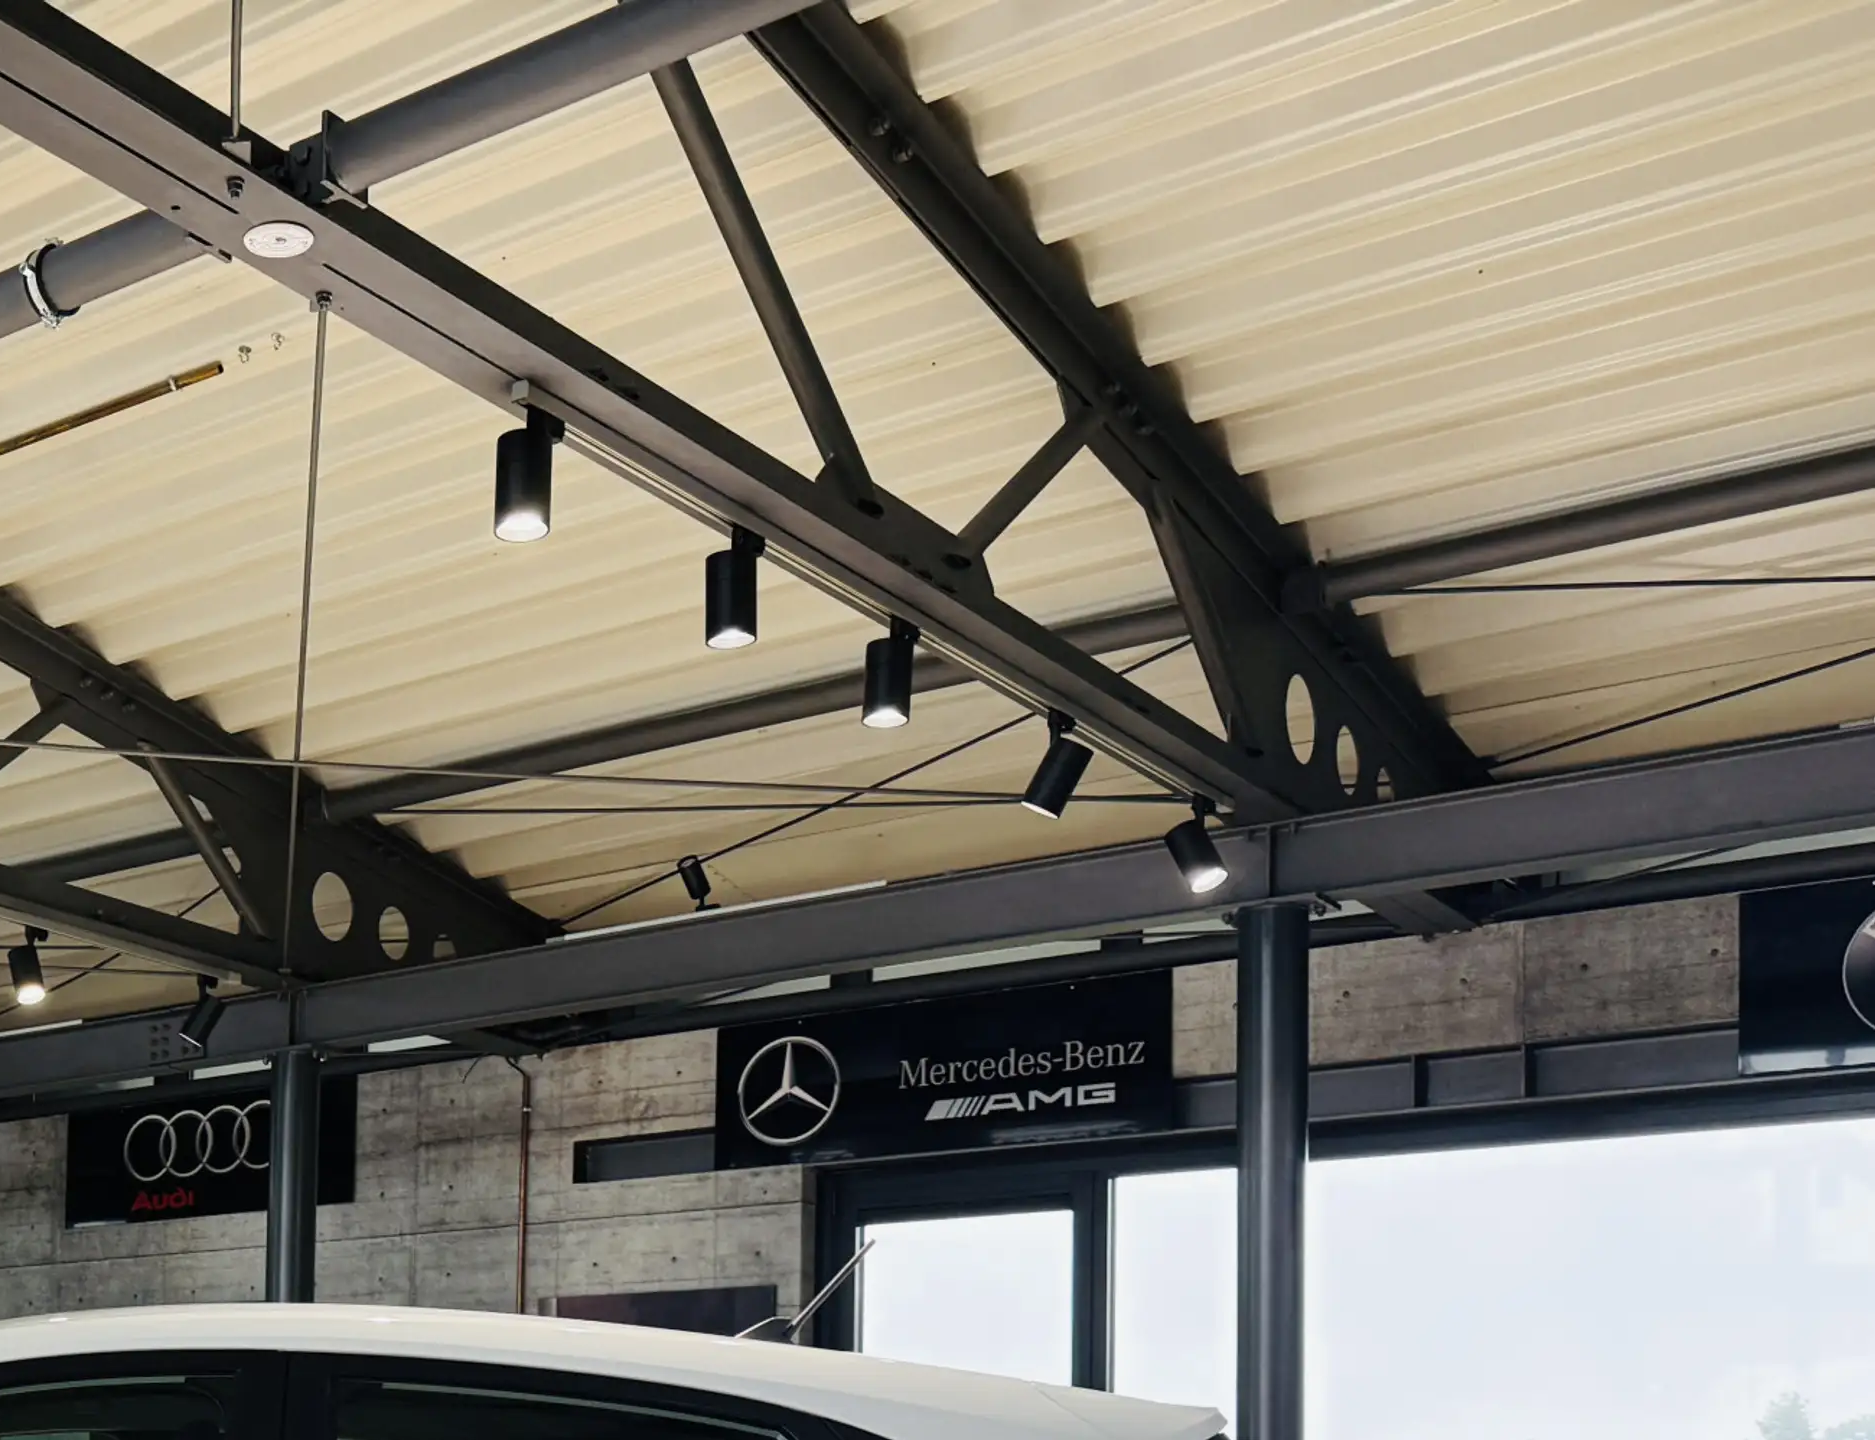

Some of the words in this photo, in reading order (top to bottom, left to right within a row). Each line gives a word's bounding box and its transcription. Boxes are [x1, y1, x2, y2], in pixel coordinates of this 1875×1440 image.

[898, 1040, 1145, 1089] Mercedes-Benz
[980, 1082, 1116, 1116] AMG
[131, 1186, 195, 1211] Audi
